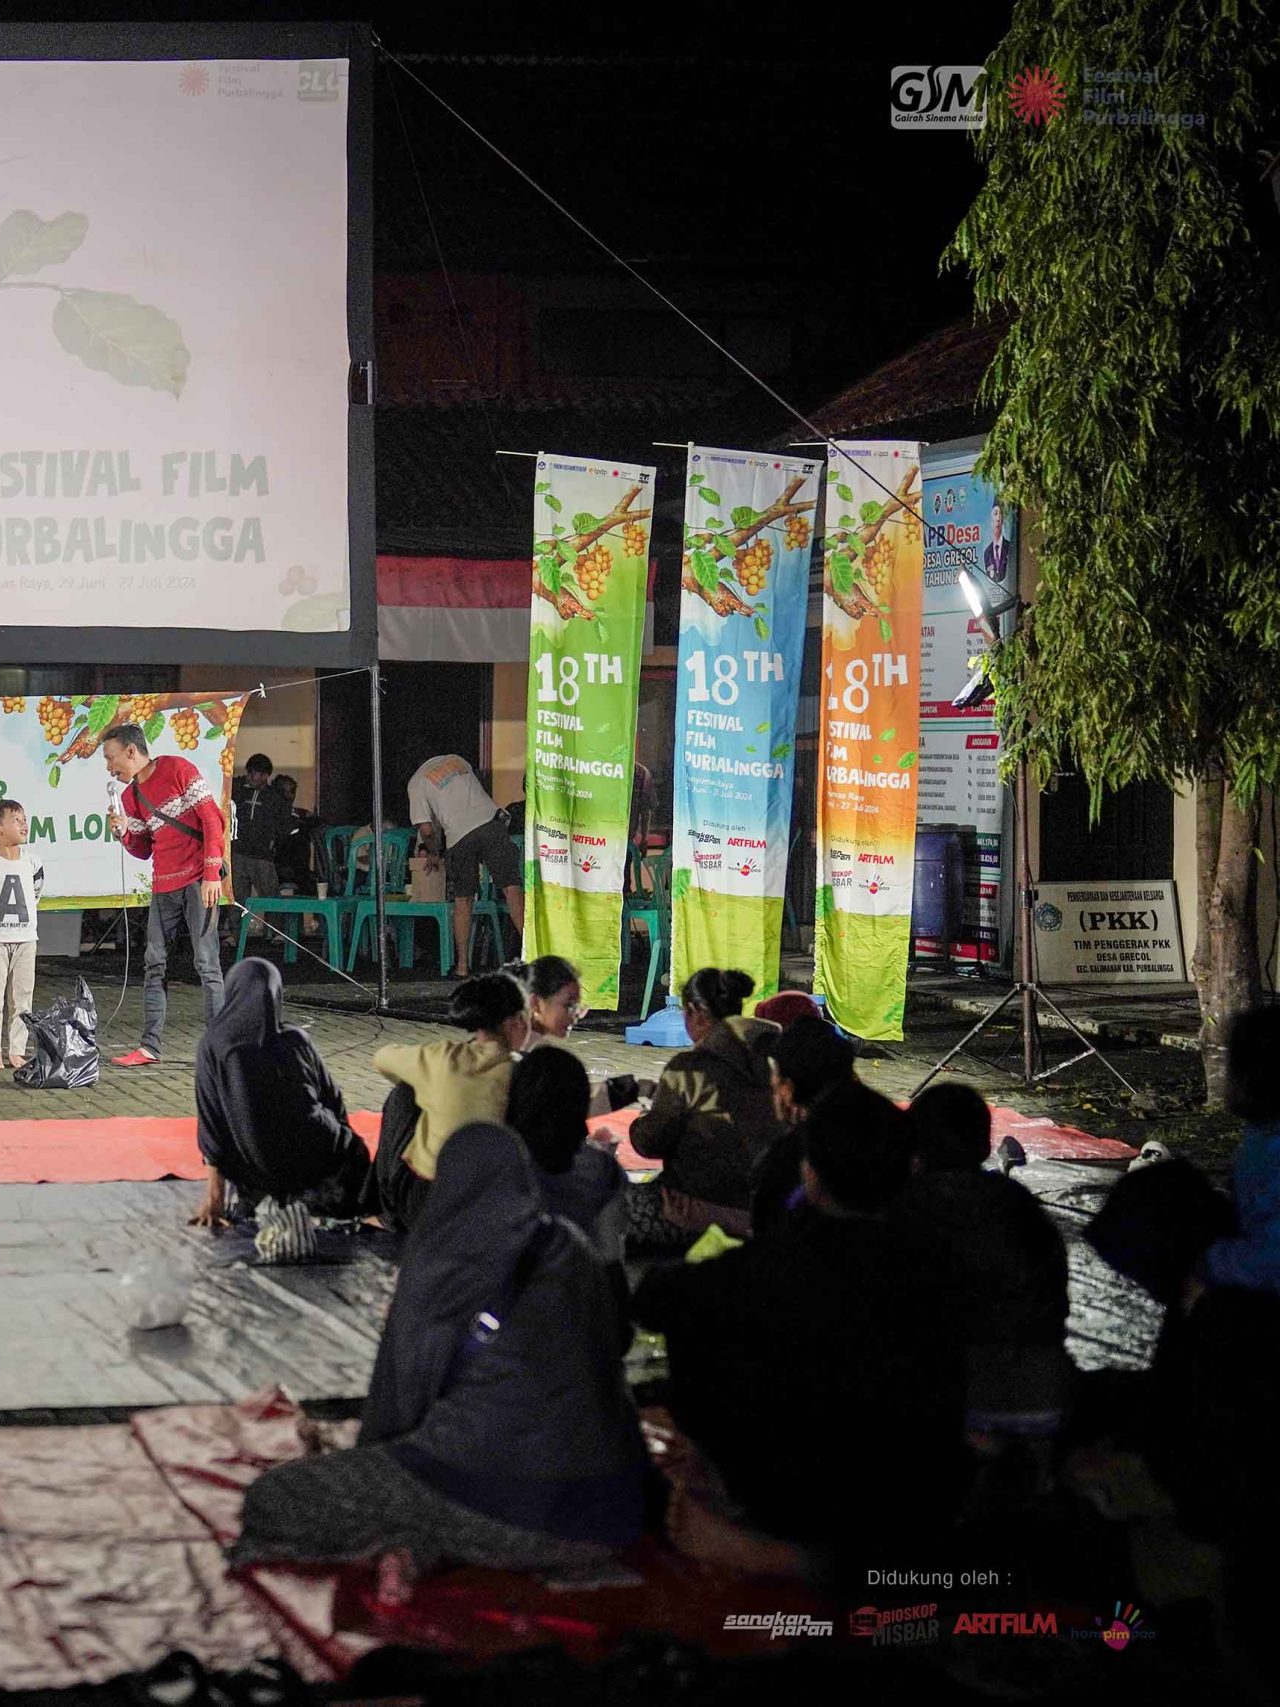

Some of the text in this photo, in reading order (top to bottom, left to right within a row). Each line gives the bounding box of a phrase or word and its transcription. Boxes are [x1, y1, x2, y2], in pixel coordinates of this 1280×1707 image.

[160, 450, 271, 498] FILM
[943, 546, 978, 567] GRECOL
[925, 569, 952, 588] TAHUN
[535, 652, 623, 706] 18TH
[685, 650, 785, 706] 18TH
[536, 709, 584, 731] FESTIVAL
[536, 730, 563, 749] FILM
[686, 730, 716, 750] FILM
[828, 720, 872, 741] STIVAL
[535, 748, 624, 779] PURBALINGGA
[572, 833, 606, 847] ARTFILM
[727, 837, 767, 849] ARTFILM
[1079, 909, 1159, 932] (PKK)
[1073, 939, 1171, 950] TIM PENGGERAK PKK
[1096, 952, 1152, 962] DESA GRECOL
[1076, 965, 1089, 974] KEC.
[1122, 964, 1135, 973] KAB.
[1136, 964, 1175, 973] PURBALINGGA
